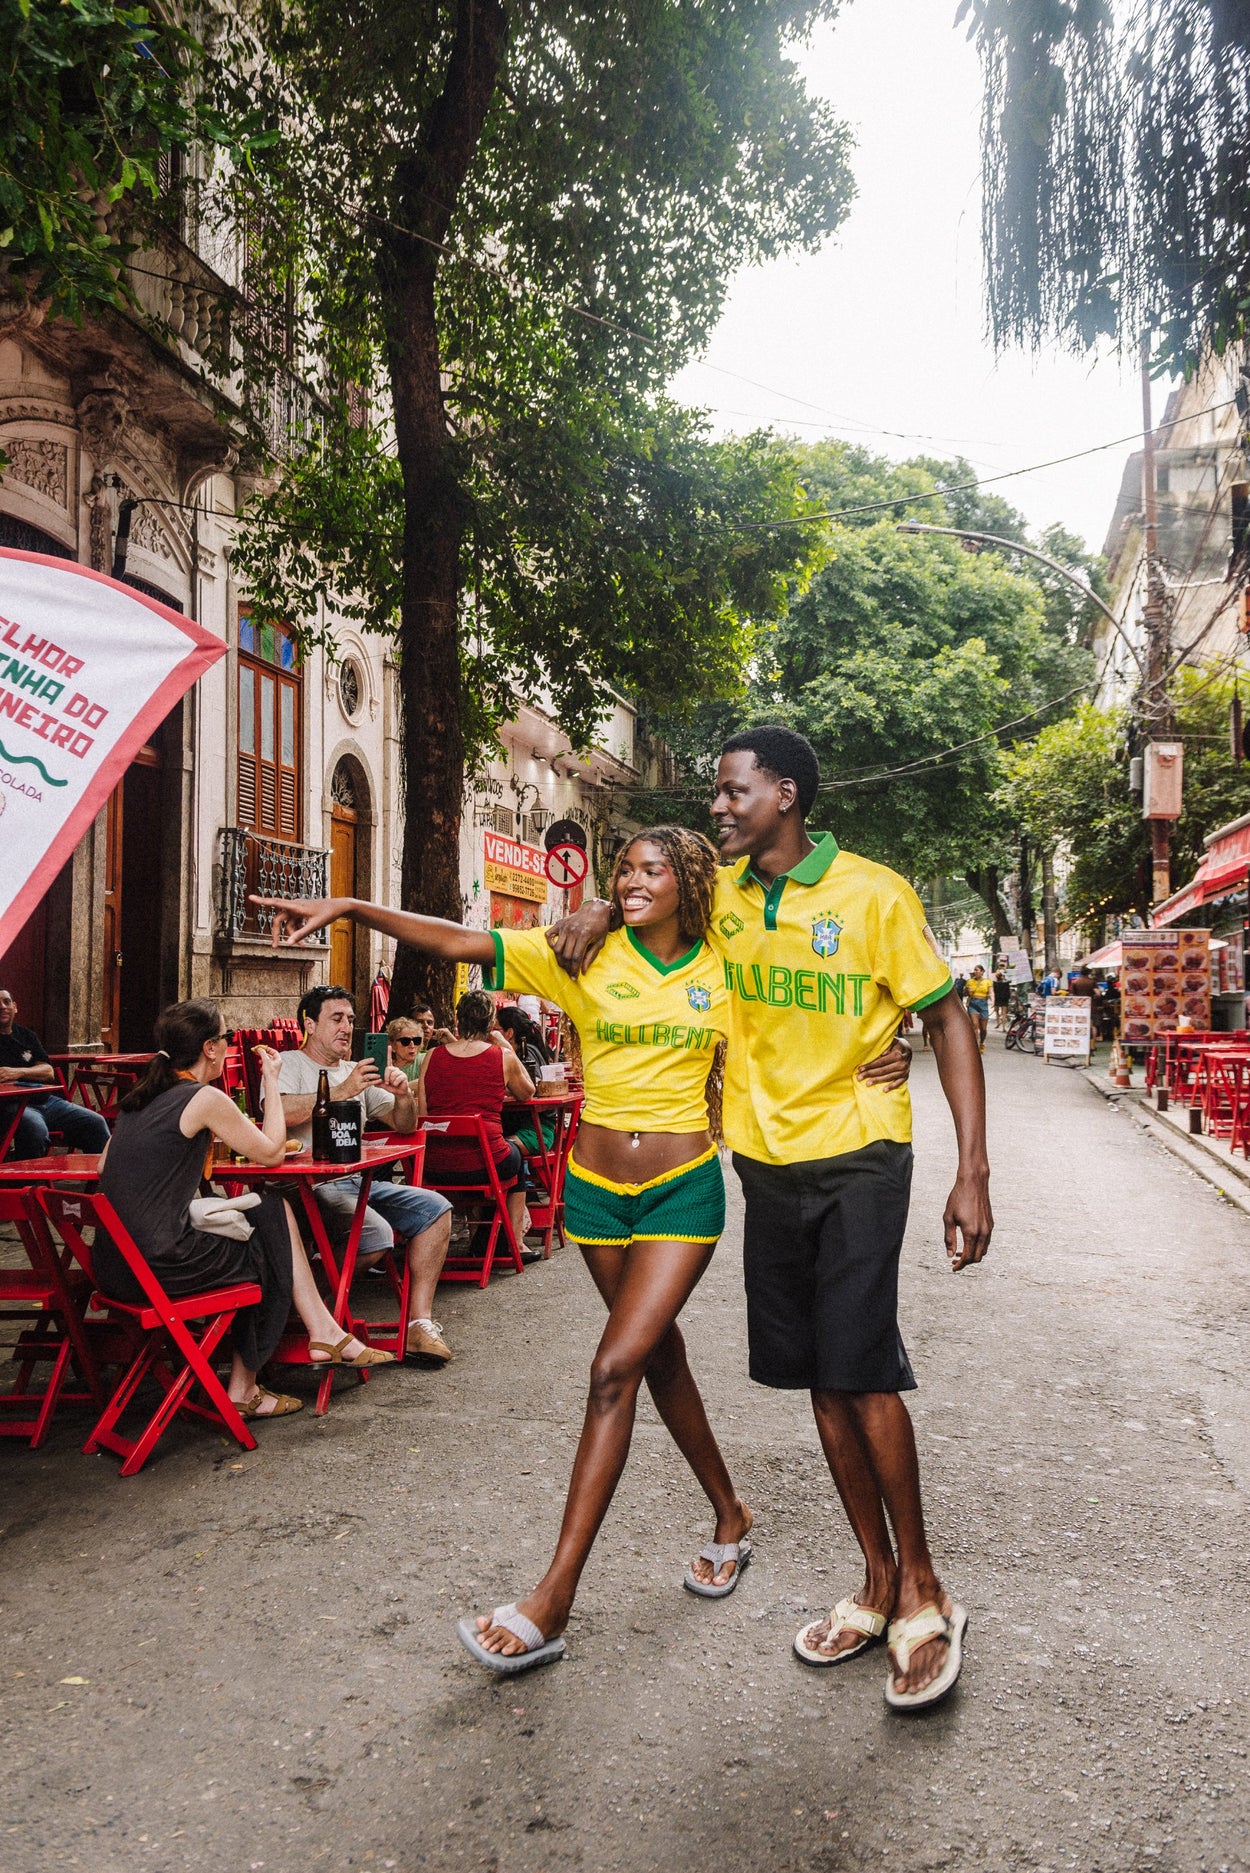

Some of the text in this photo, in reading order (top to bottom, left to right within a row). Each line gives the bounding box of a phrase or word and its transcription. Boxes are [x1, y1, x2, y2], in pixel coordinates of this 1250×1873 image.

[0, 687, 95, 759] NEIRO
[62, 692, 109, 730] DO
[723, 955, 872, 1017] LLBENT
[596, 1018, 715, 1051] HELLBENT
[331, 1131, 351, 1139] BOA
[335, 1138, 358, 1147] IDEIA
[337, 1122, 357, 1131] UMA
